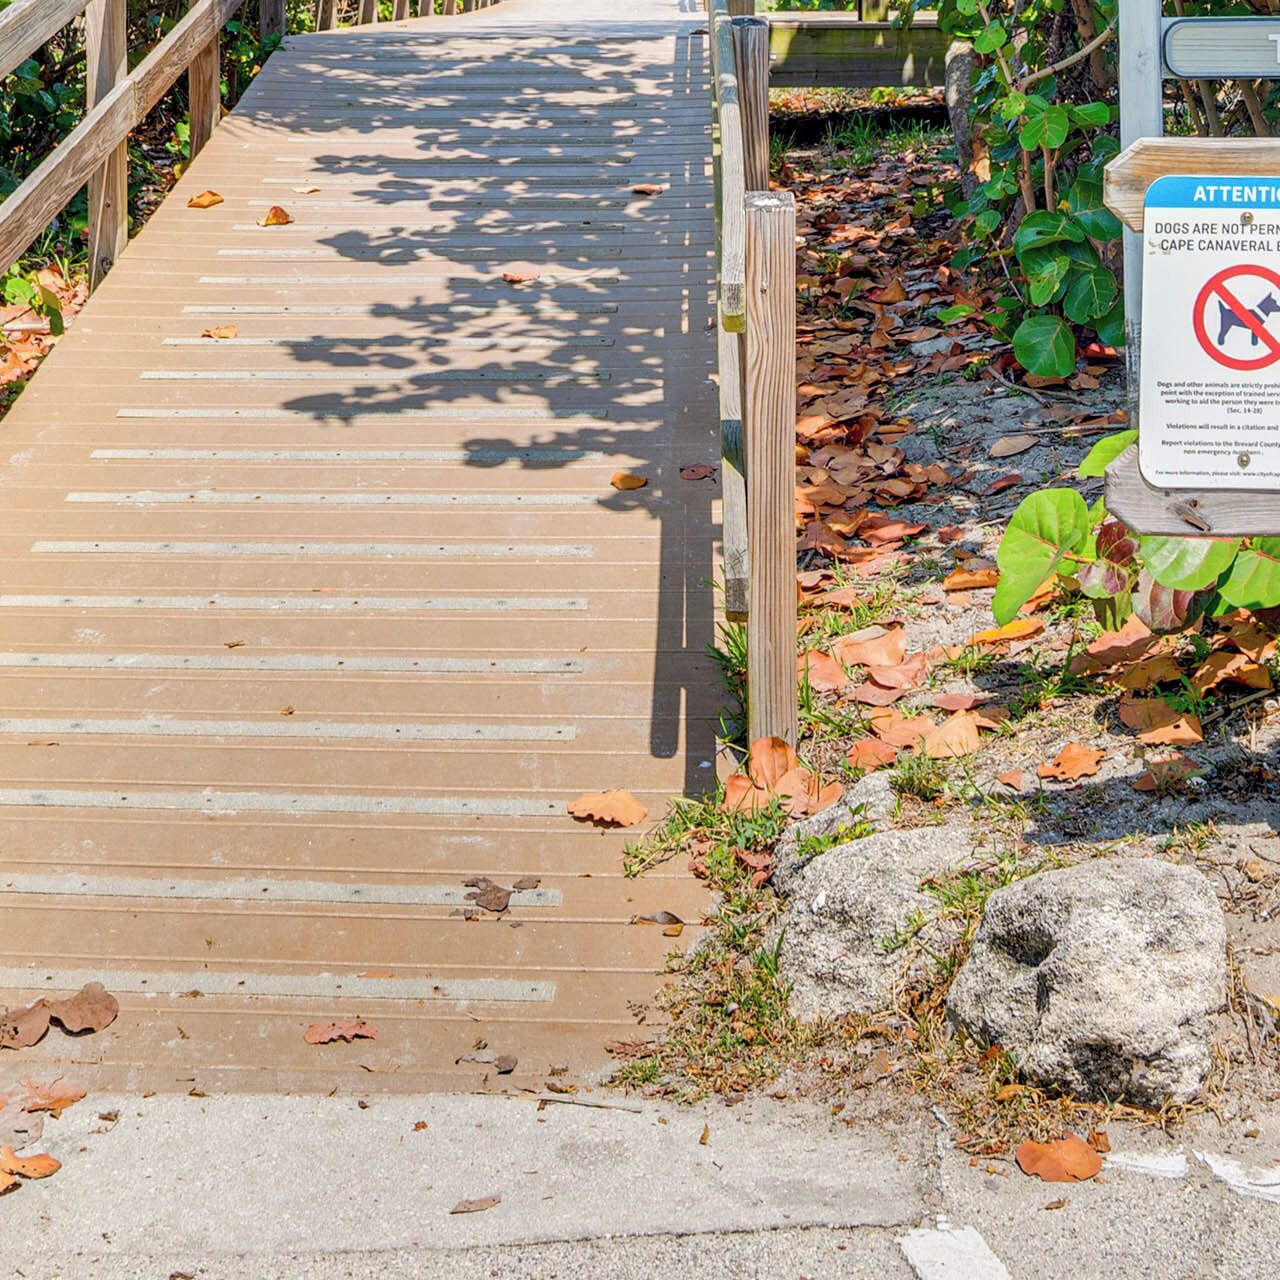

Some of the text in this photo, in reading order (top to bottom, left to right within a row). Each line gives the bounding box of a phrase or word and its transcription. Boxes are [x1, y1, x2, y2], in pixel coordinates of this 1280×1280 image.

[1155, 222, 1189, 235] DOGS
[1192, 223, 1218, 236] ARE
[1222, 223, 1246, 236] NOT
[1160, 239, 1194, 252] CAPE
[1198, 239, 1273, 252] CANAVERAL
